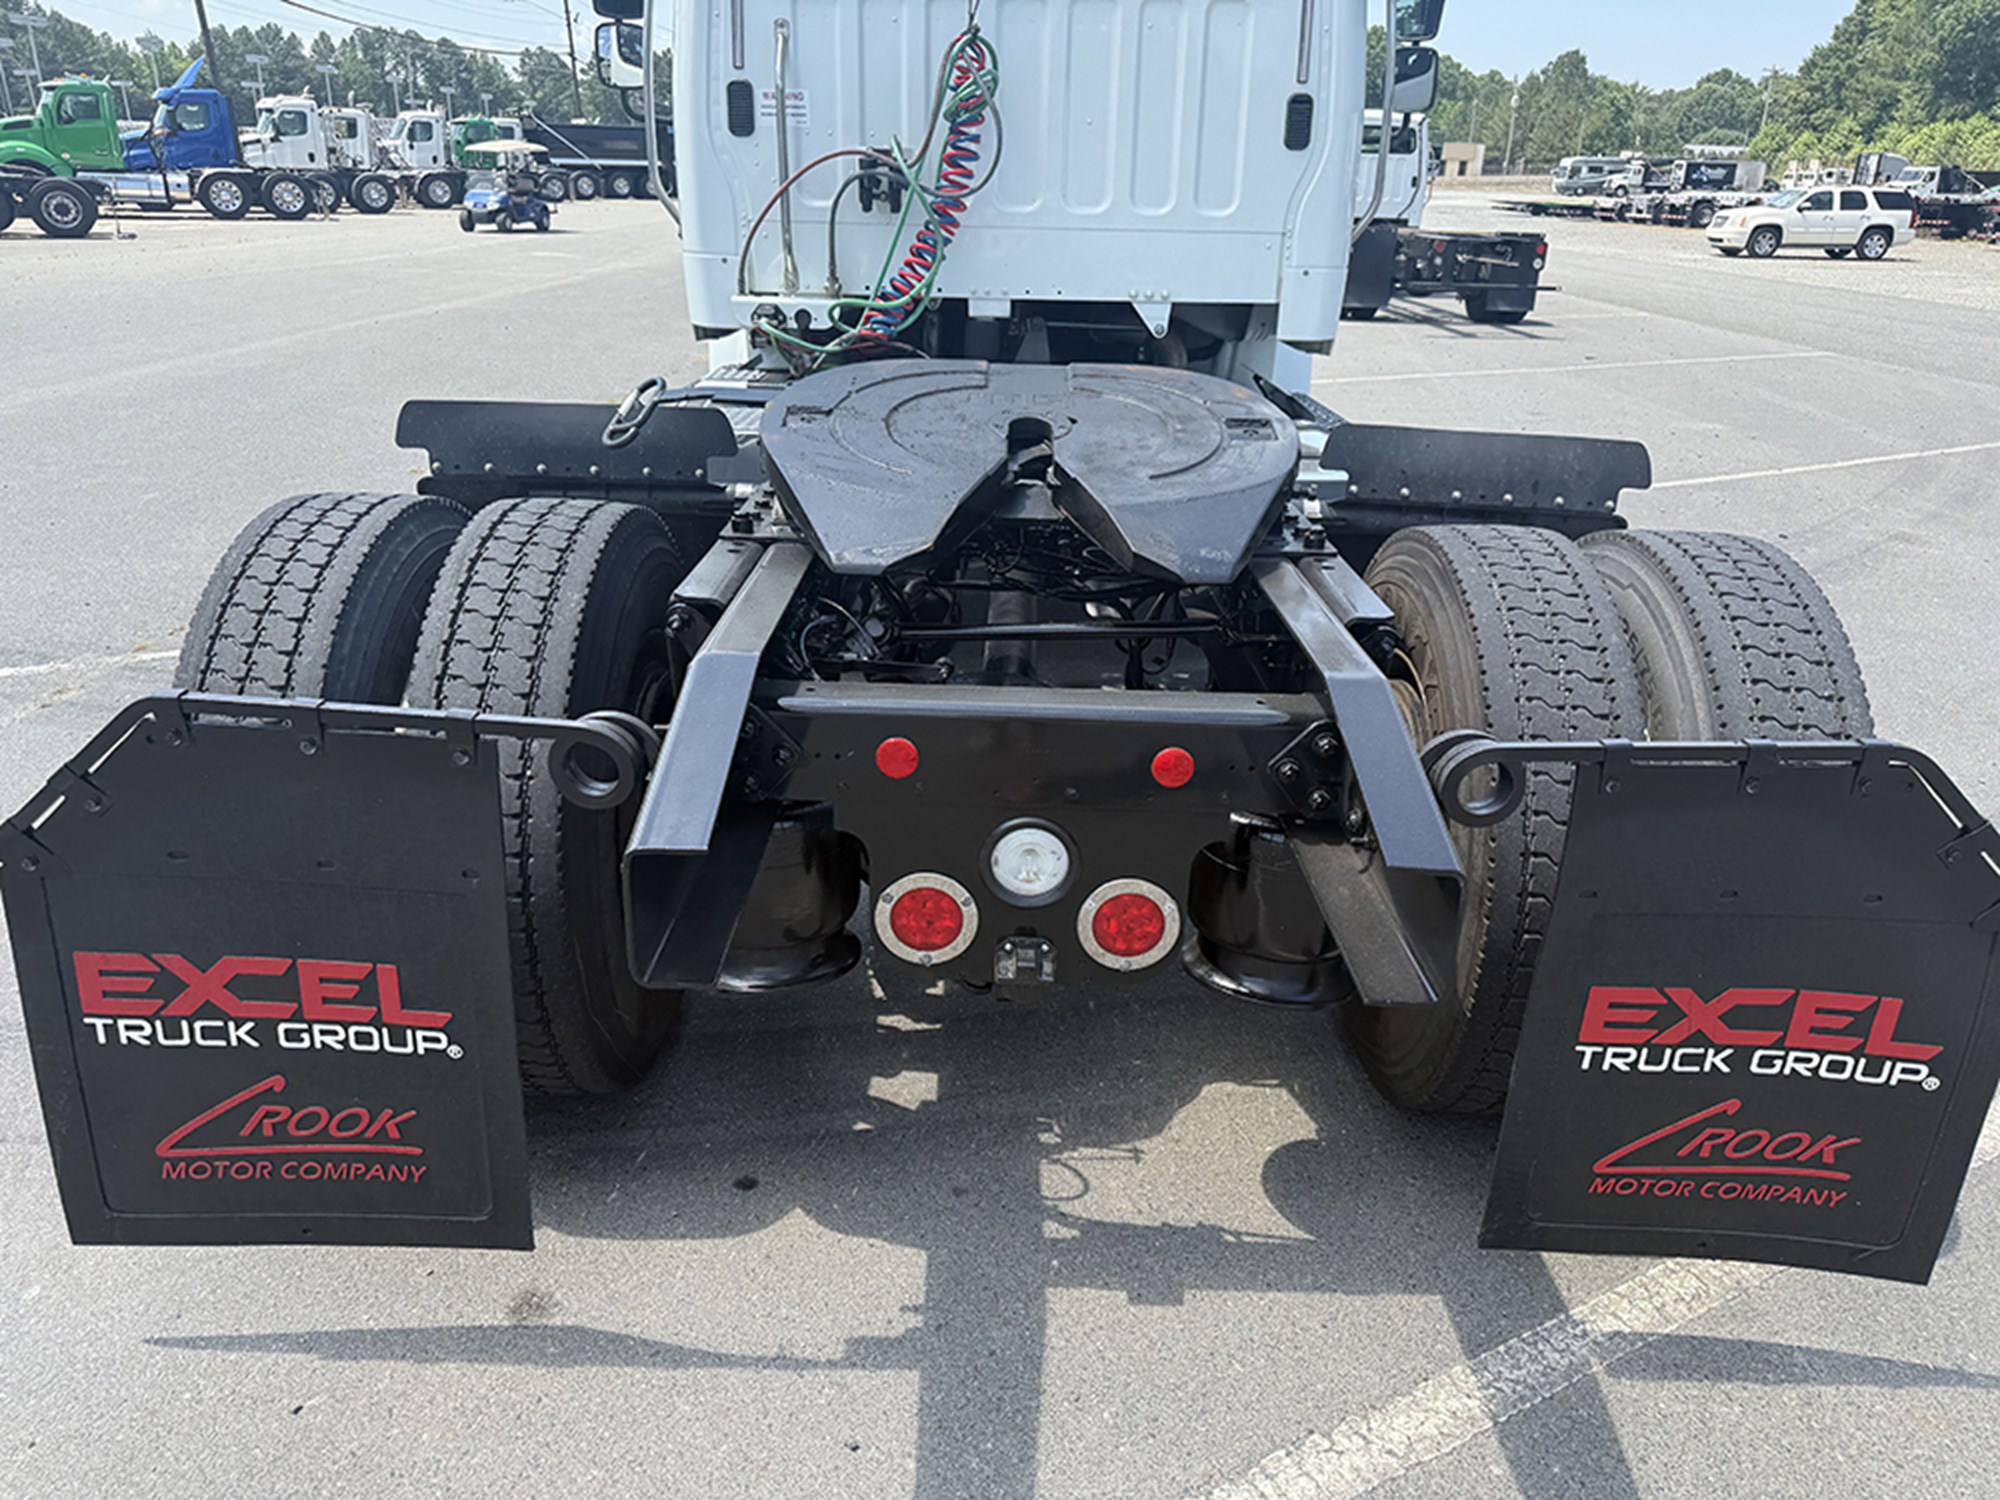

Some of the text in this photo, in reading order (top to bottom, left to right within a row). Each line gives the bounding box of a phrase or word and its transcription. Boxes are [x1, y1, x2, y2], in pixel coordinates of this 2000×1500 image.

[73, 951, 453, 1028] EXCEL
[83, 1017, 260, 1048] TRUCK
[1578, 986, 1944, 1061] EXCEL
[1574, 1045, 1734, 1073] TRUCK
[162, 1161, 427, 1183] MOTOR COMPANY
[1588, 1177, 1848, 1208] MOTOR COMPANY
